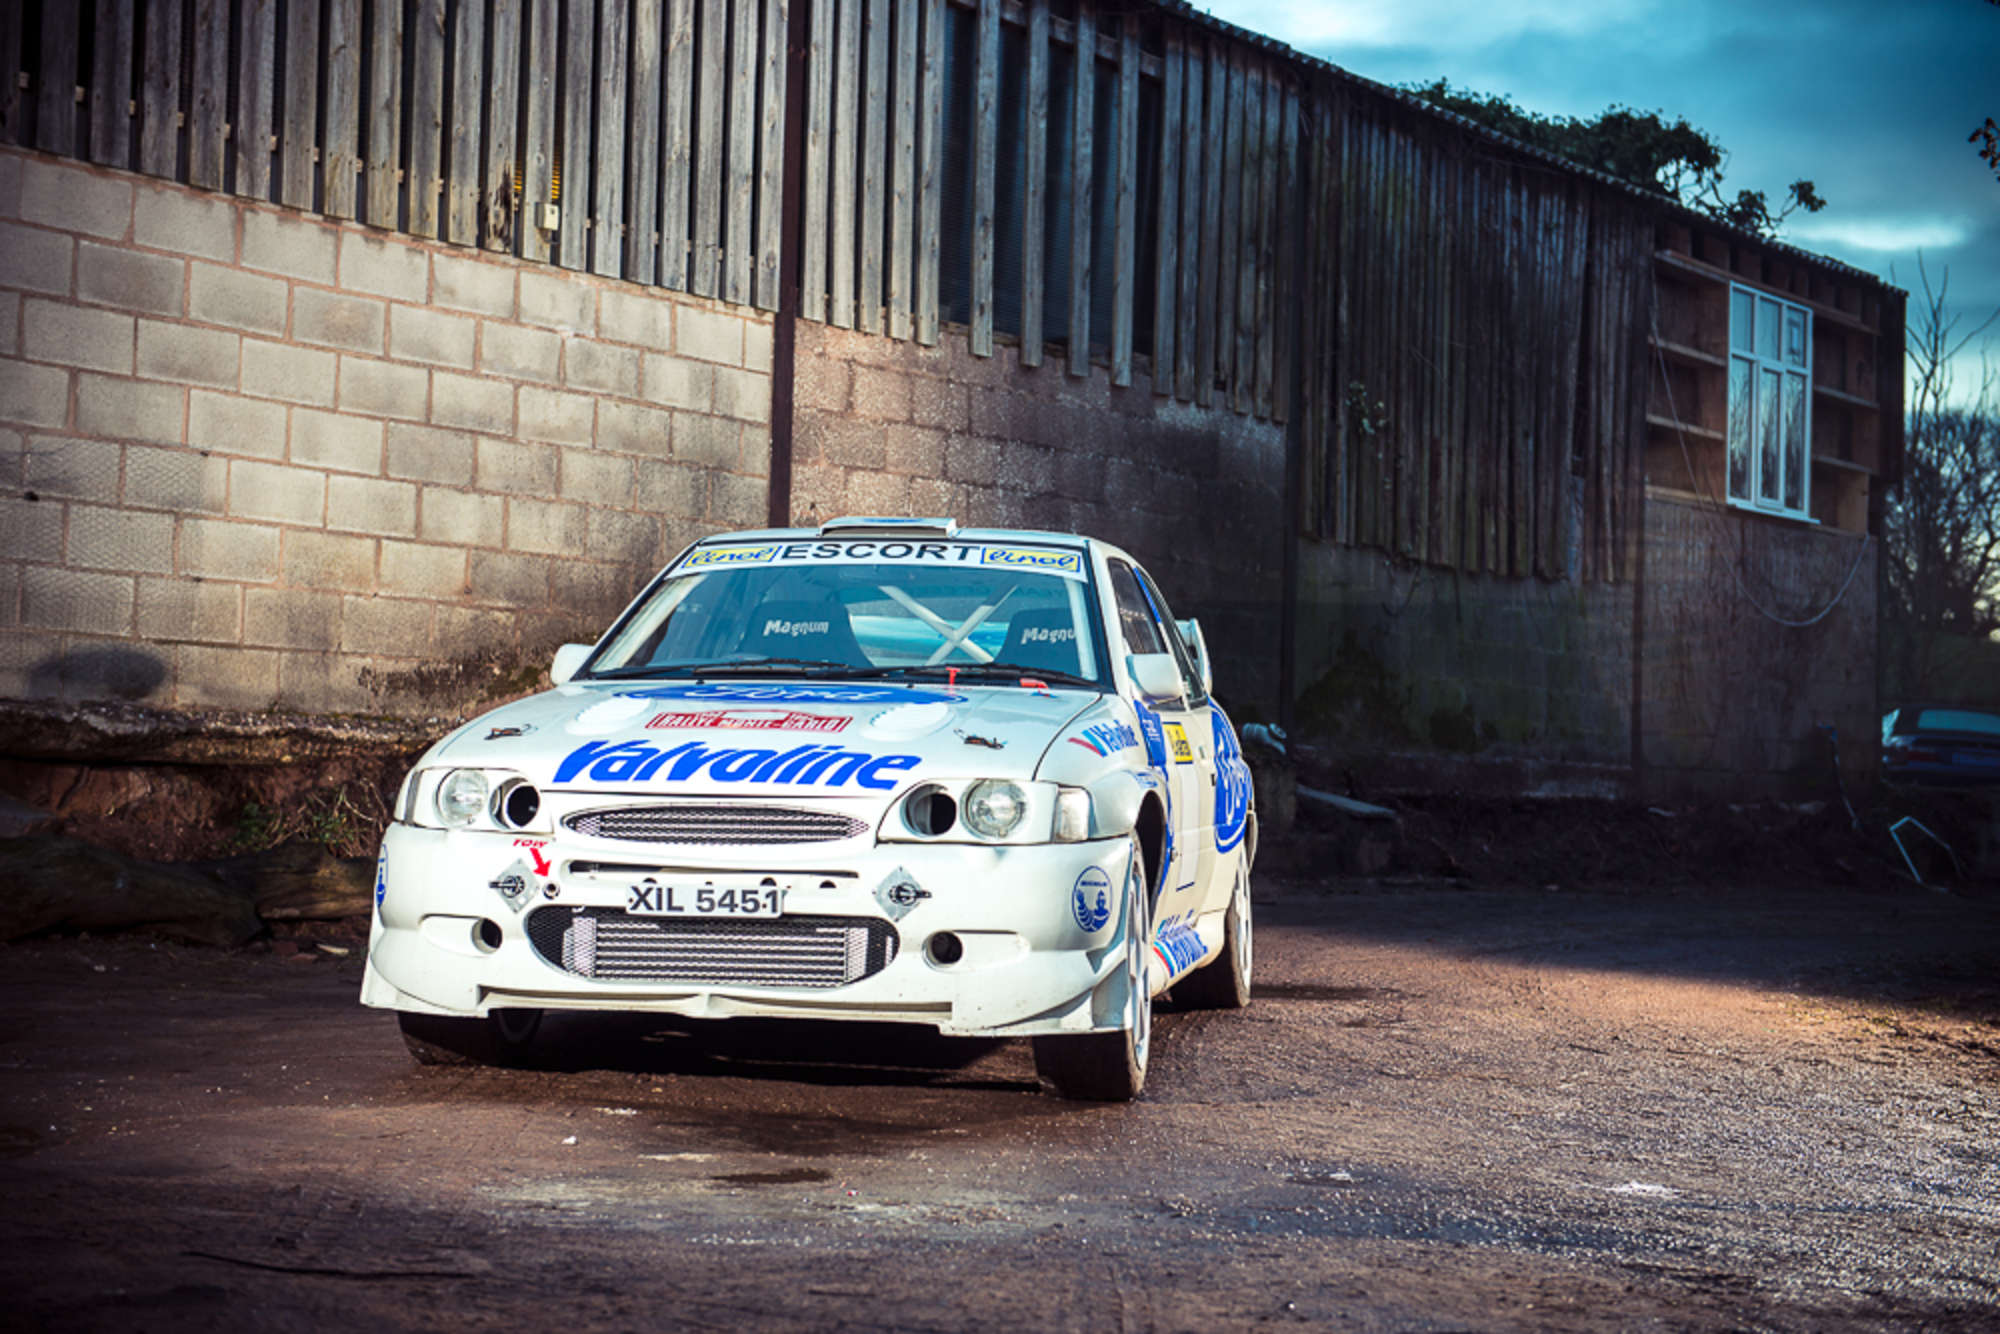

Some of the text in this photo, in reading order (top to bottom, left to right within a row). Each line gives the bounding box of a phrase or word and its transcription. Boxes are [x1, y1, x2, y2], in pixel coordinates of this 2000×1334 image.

[780, 543, 981, 561] ESCORT
[762, 618, 830, 637] Magnum
[1020, 626, 1077, 645] Magnu
[551, 739, 923, 791] Valvoline
[512, 838, 549, 849] TOW
[629, 885, 779, 913] XIL 5451
